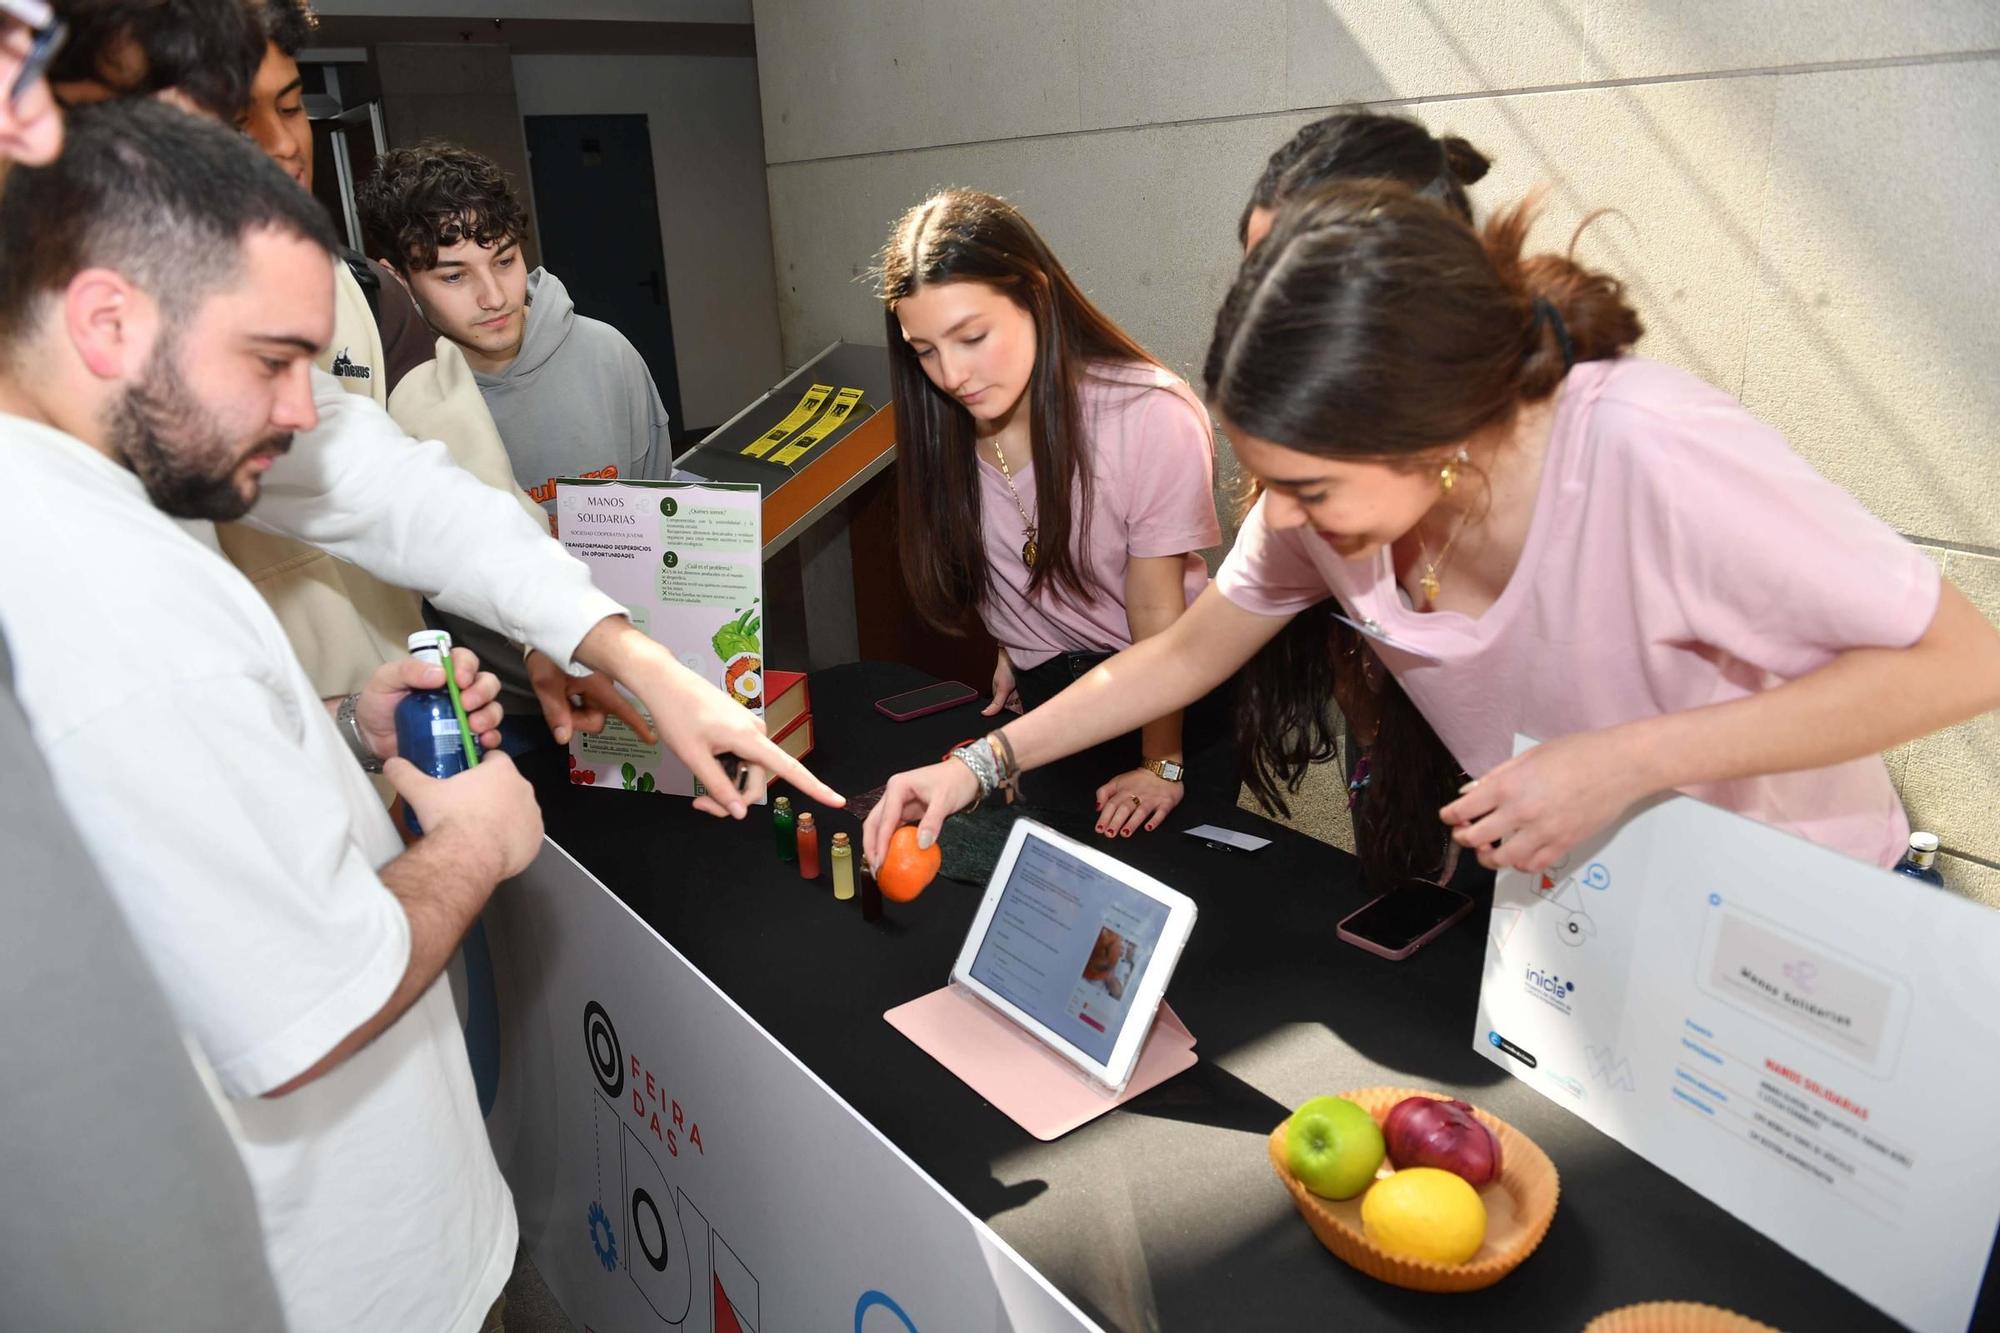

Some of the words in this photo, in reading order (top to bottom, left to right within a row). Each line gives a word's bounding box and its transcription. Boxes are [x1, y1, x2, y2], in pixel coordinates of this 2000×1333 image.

[587, 497, 625, 508] MANOS
[666, 503, 672, 512] 1
[577, 513, 636, 525] SOLIDARIAS
[565, 542, 613, 550] TRANSFORMANDO
[590, 551, 635, 559] OPORTUNIDADES
[667, 554, 674, 563] 2
[1526, 963, 1566, 999] inicia
[631, 1054, 704, 1156] FEIRA
[633, 1088, 678, 1157] DAS
